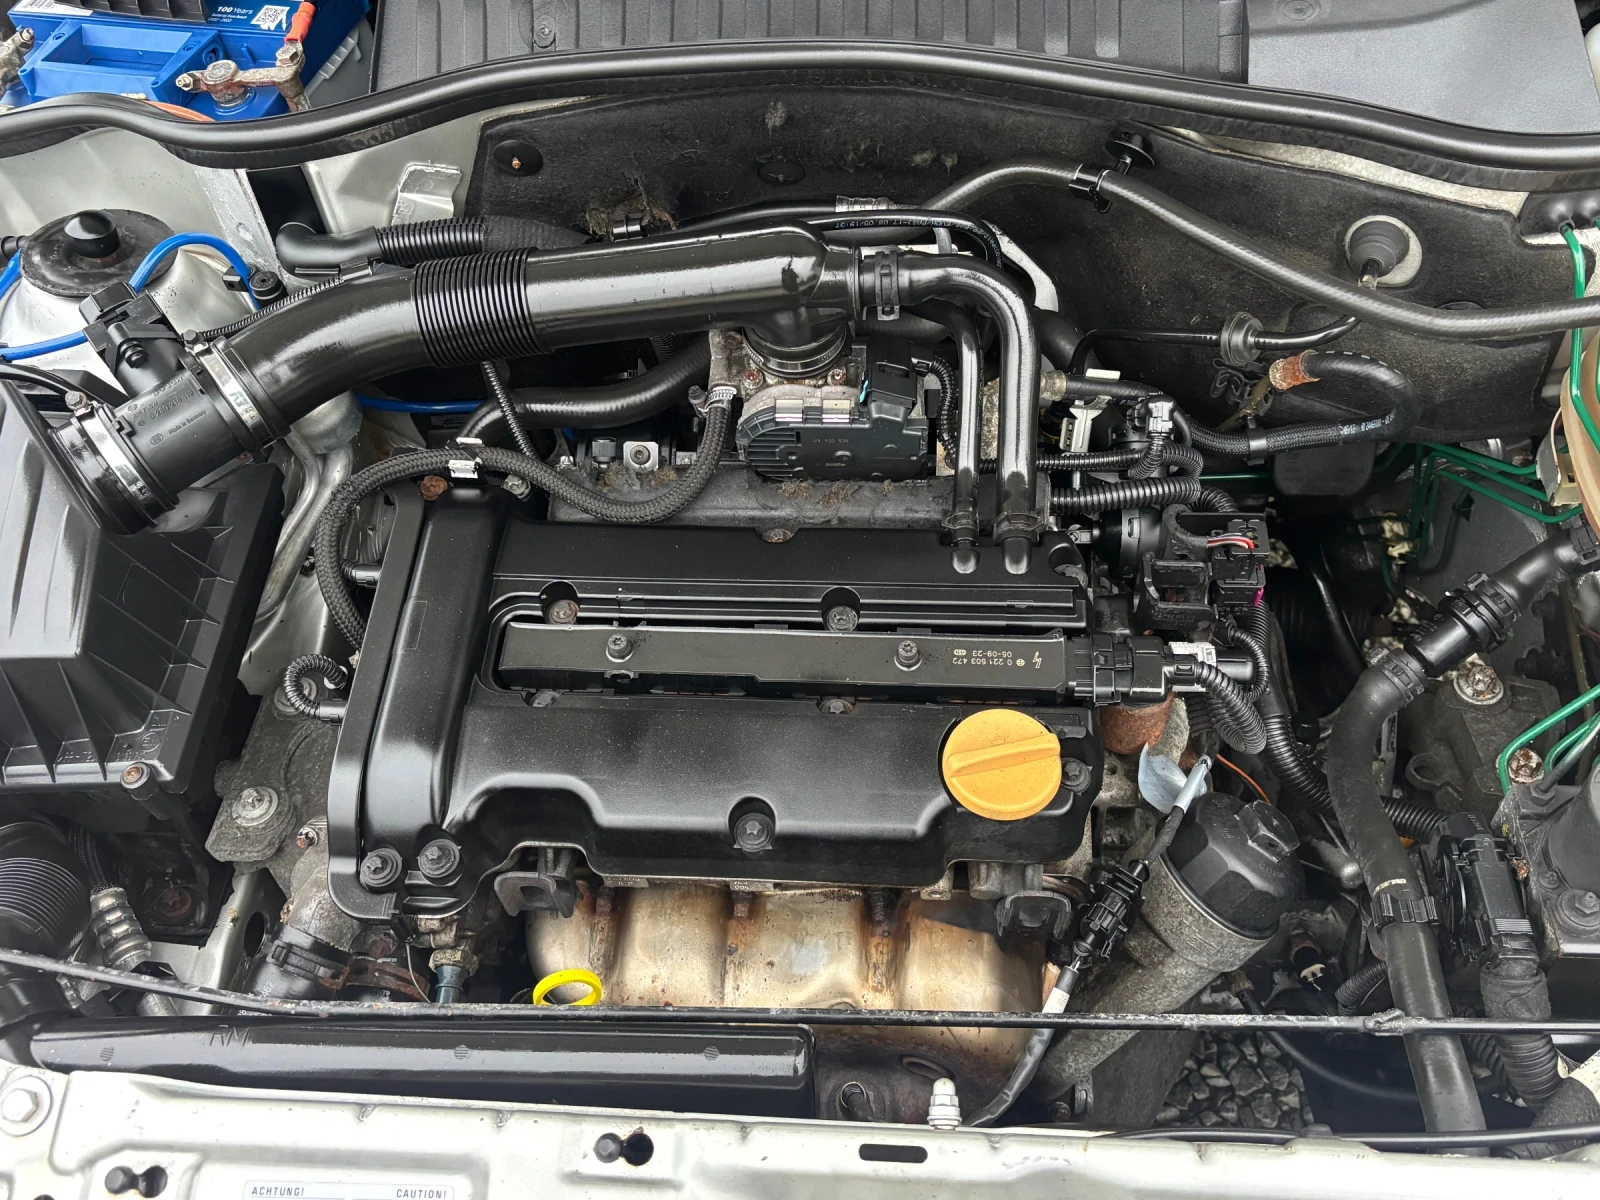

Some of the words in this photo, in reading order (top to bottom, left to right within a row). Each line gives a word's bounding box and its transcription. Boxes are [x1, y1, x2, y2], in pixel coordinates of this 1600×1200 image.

[156, 405, 170, 416] 280
[168, 424, 181, 434] Made
[186, 410, 207, 424] Germany
[972, 650, 1012, 658] 05-09-23
[251, 1186, 305, 1197] ACHTUNG!
[396, 1188, 448, 1199] CAUTION!
